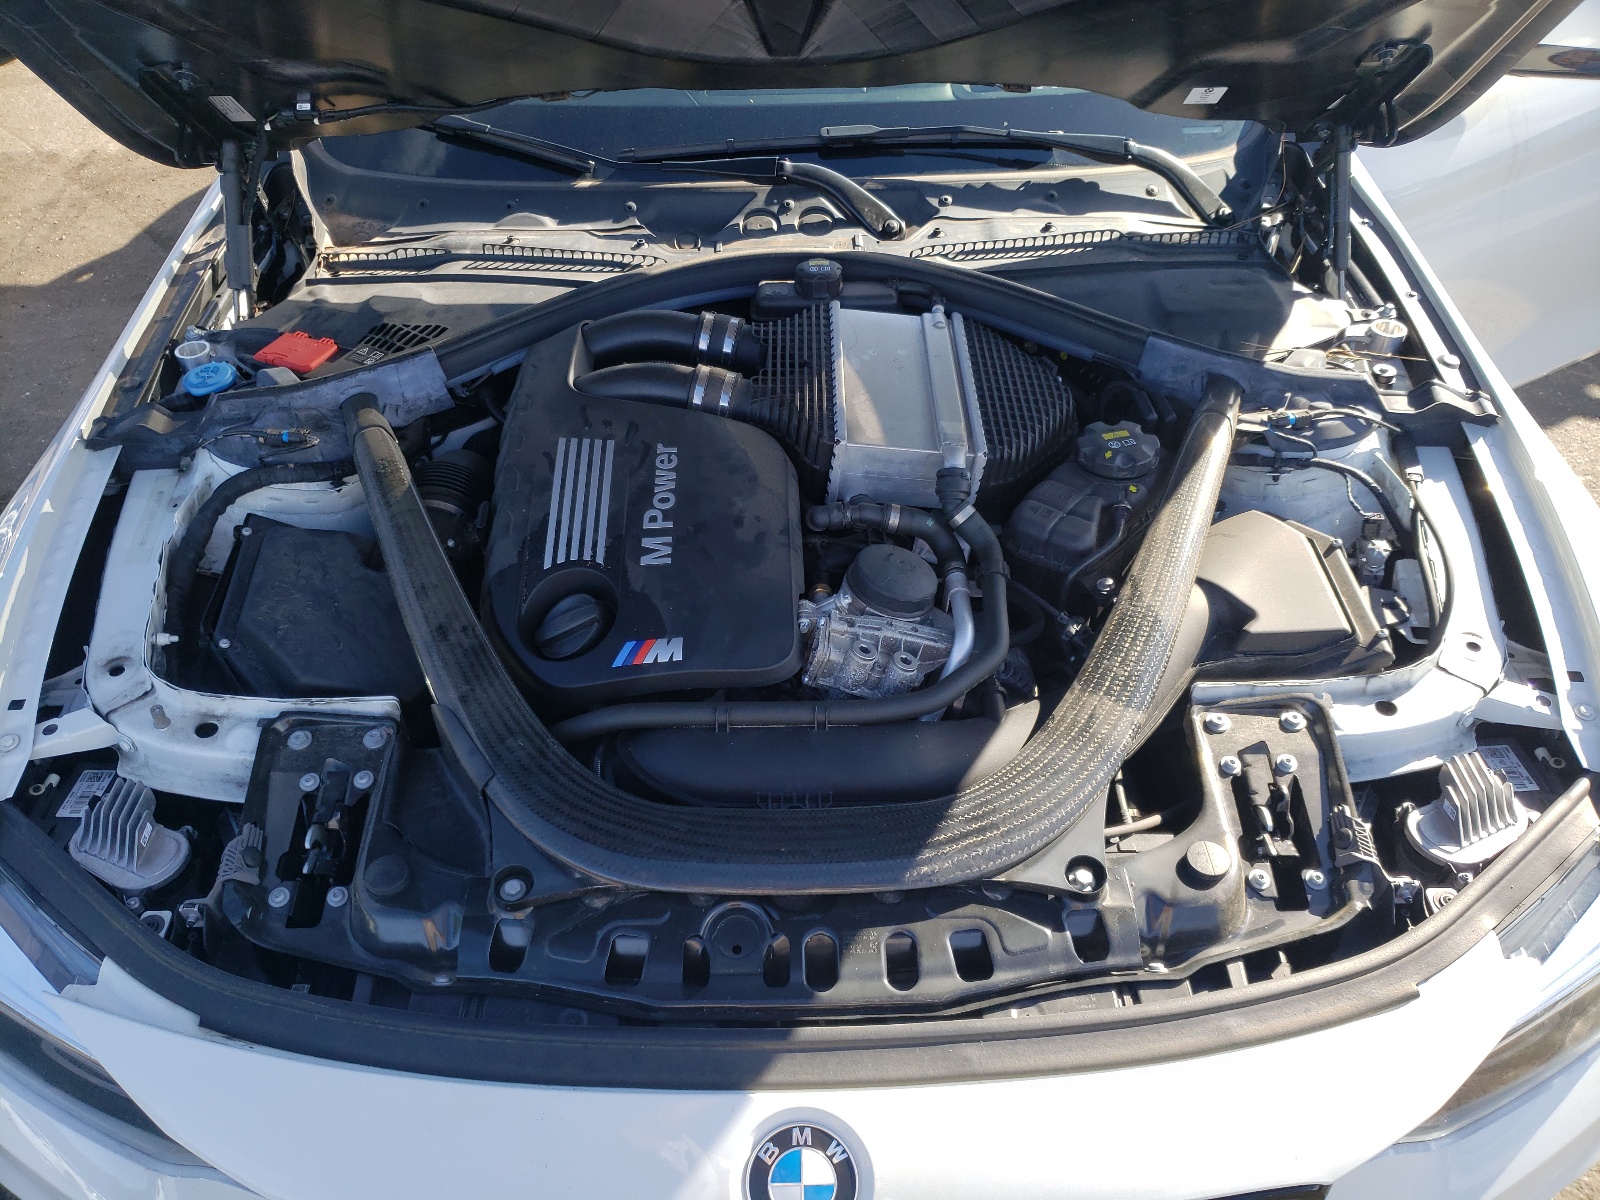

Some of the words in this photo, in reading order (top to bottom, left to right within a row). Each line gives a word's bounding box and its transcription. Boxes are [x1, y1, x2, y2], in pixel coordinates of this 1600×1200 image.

[643, 443, 678, 529] Power
[640, 536, 672, 566] M
[757, 1126, 849, 1166] BMW
